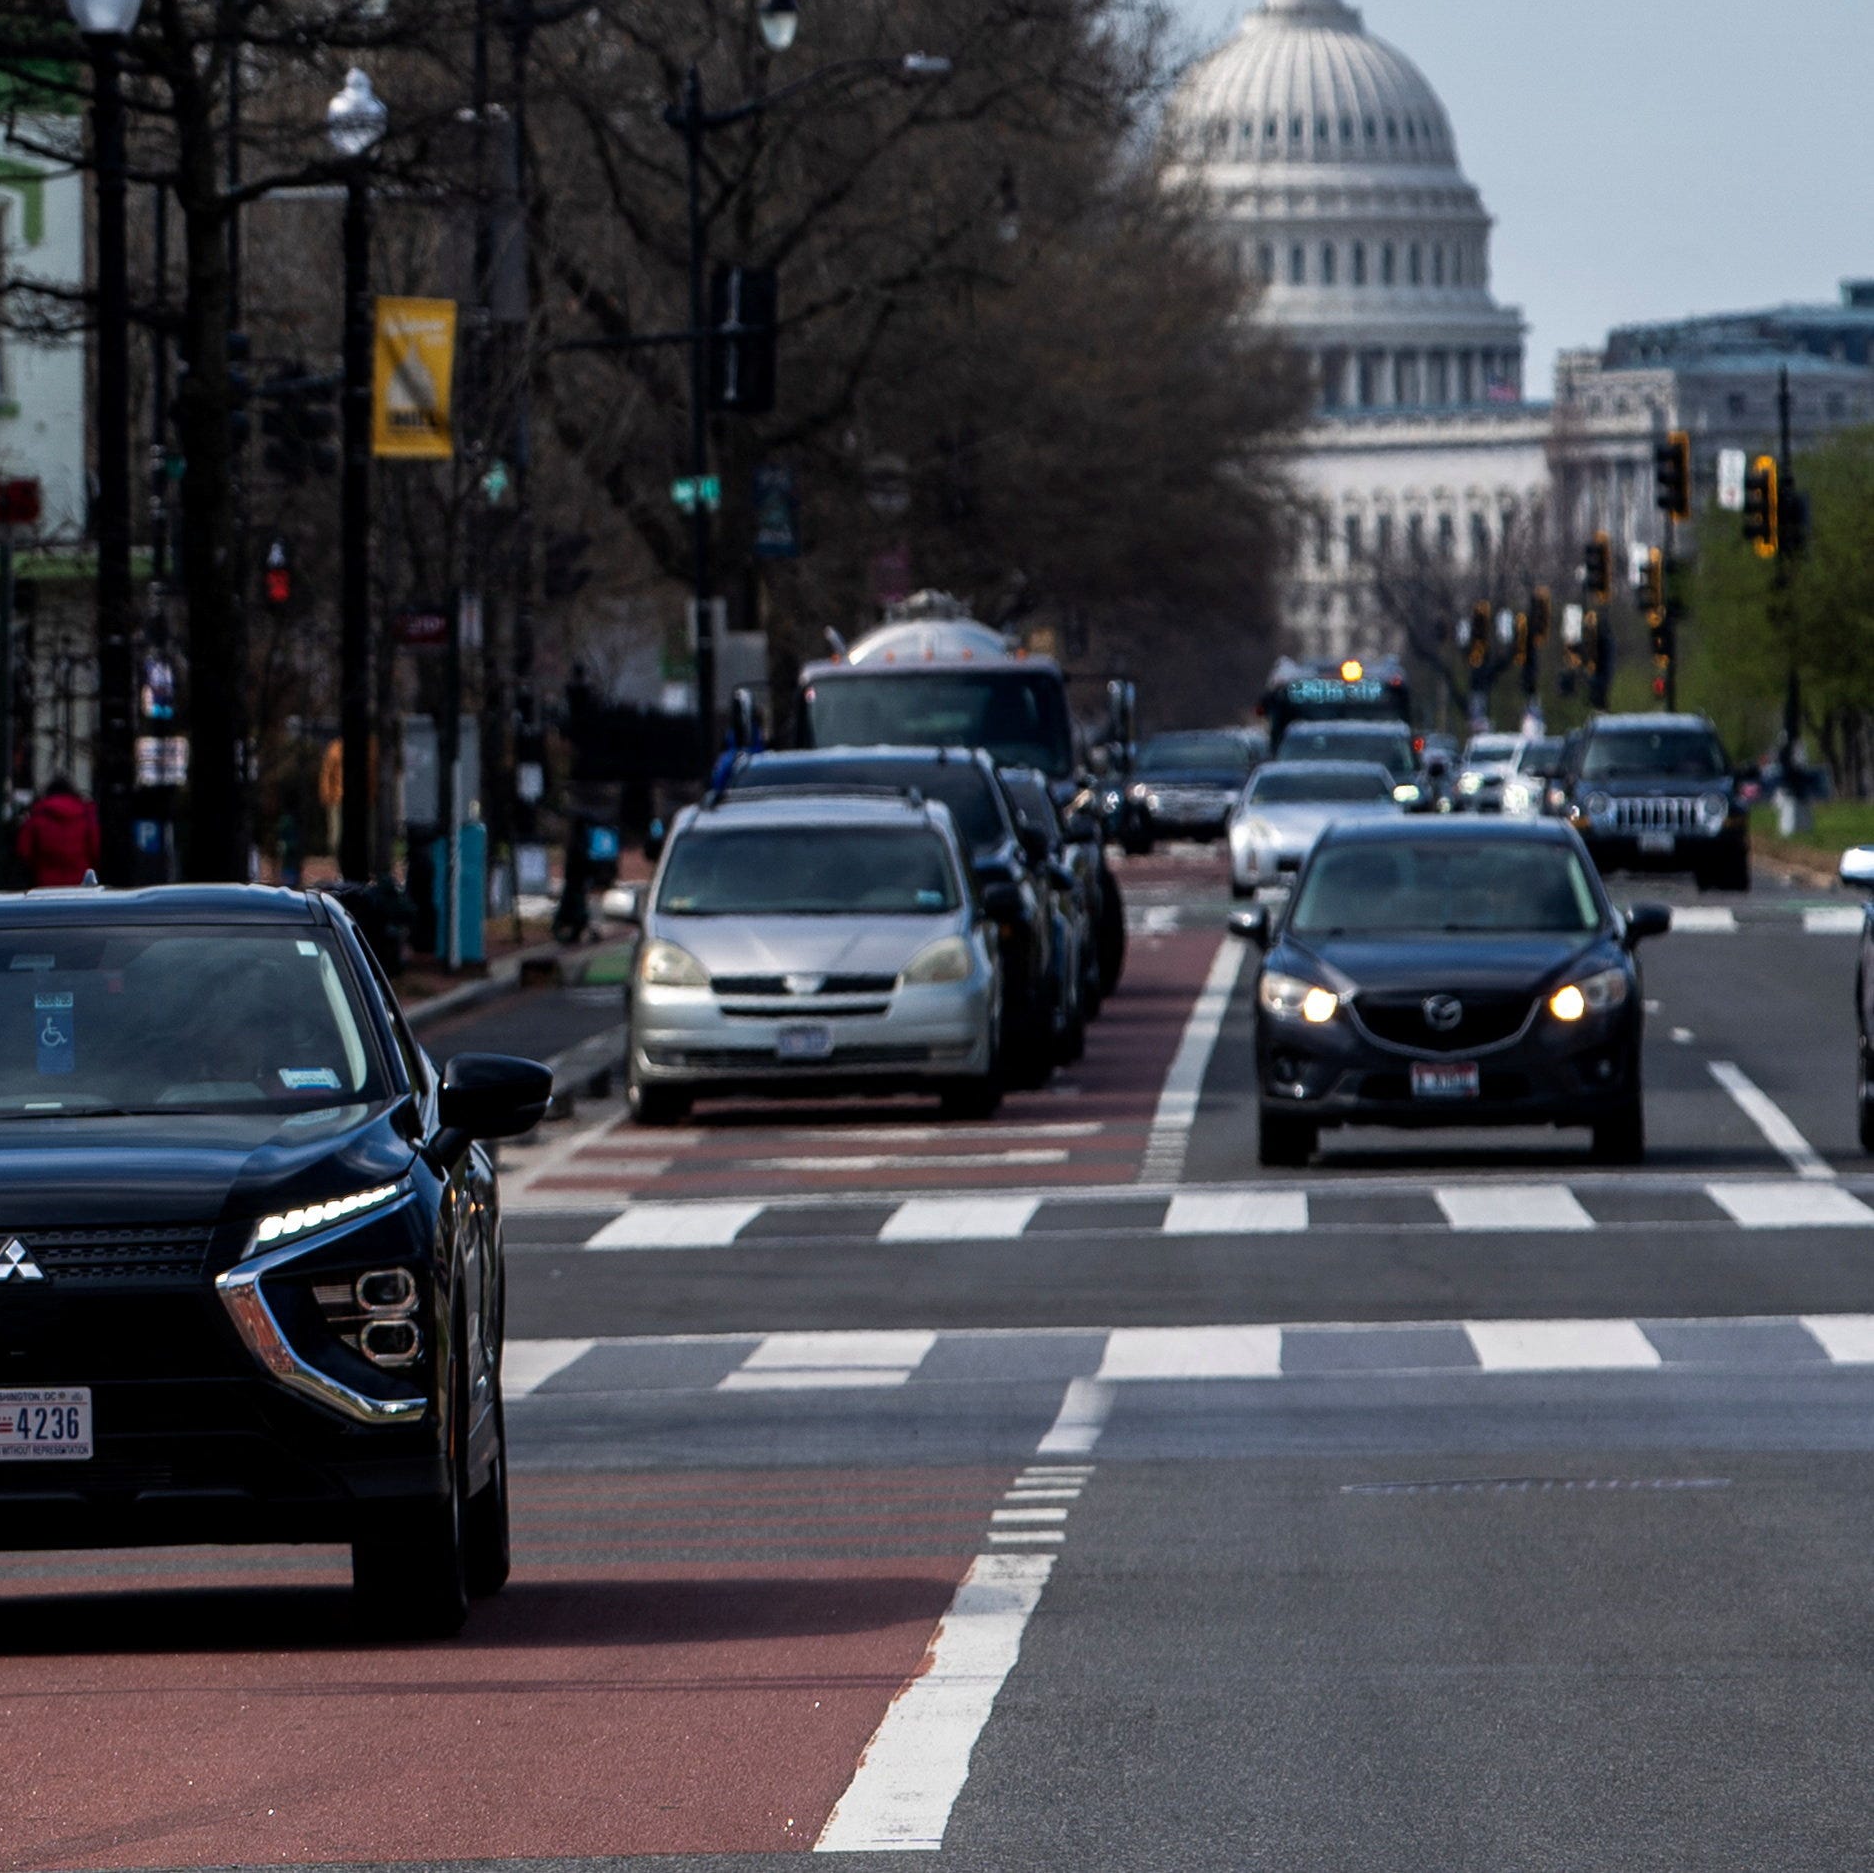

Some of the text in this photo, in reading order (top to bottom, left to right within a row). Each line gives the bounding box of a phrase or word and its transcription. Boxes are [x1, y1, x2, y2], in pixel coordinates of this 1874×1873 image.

[44, 1392, 56, 1401] DC
[16, 1406, 80, 1441] 4236
[2, 1445, 31, 1455] WITHOUT
